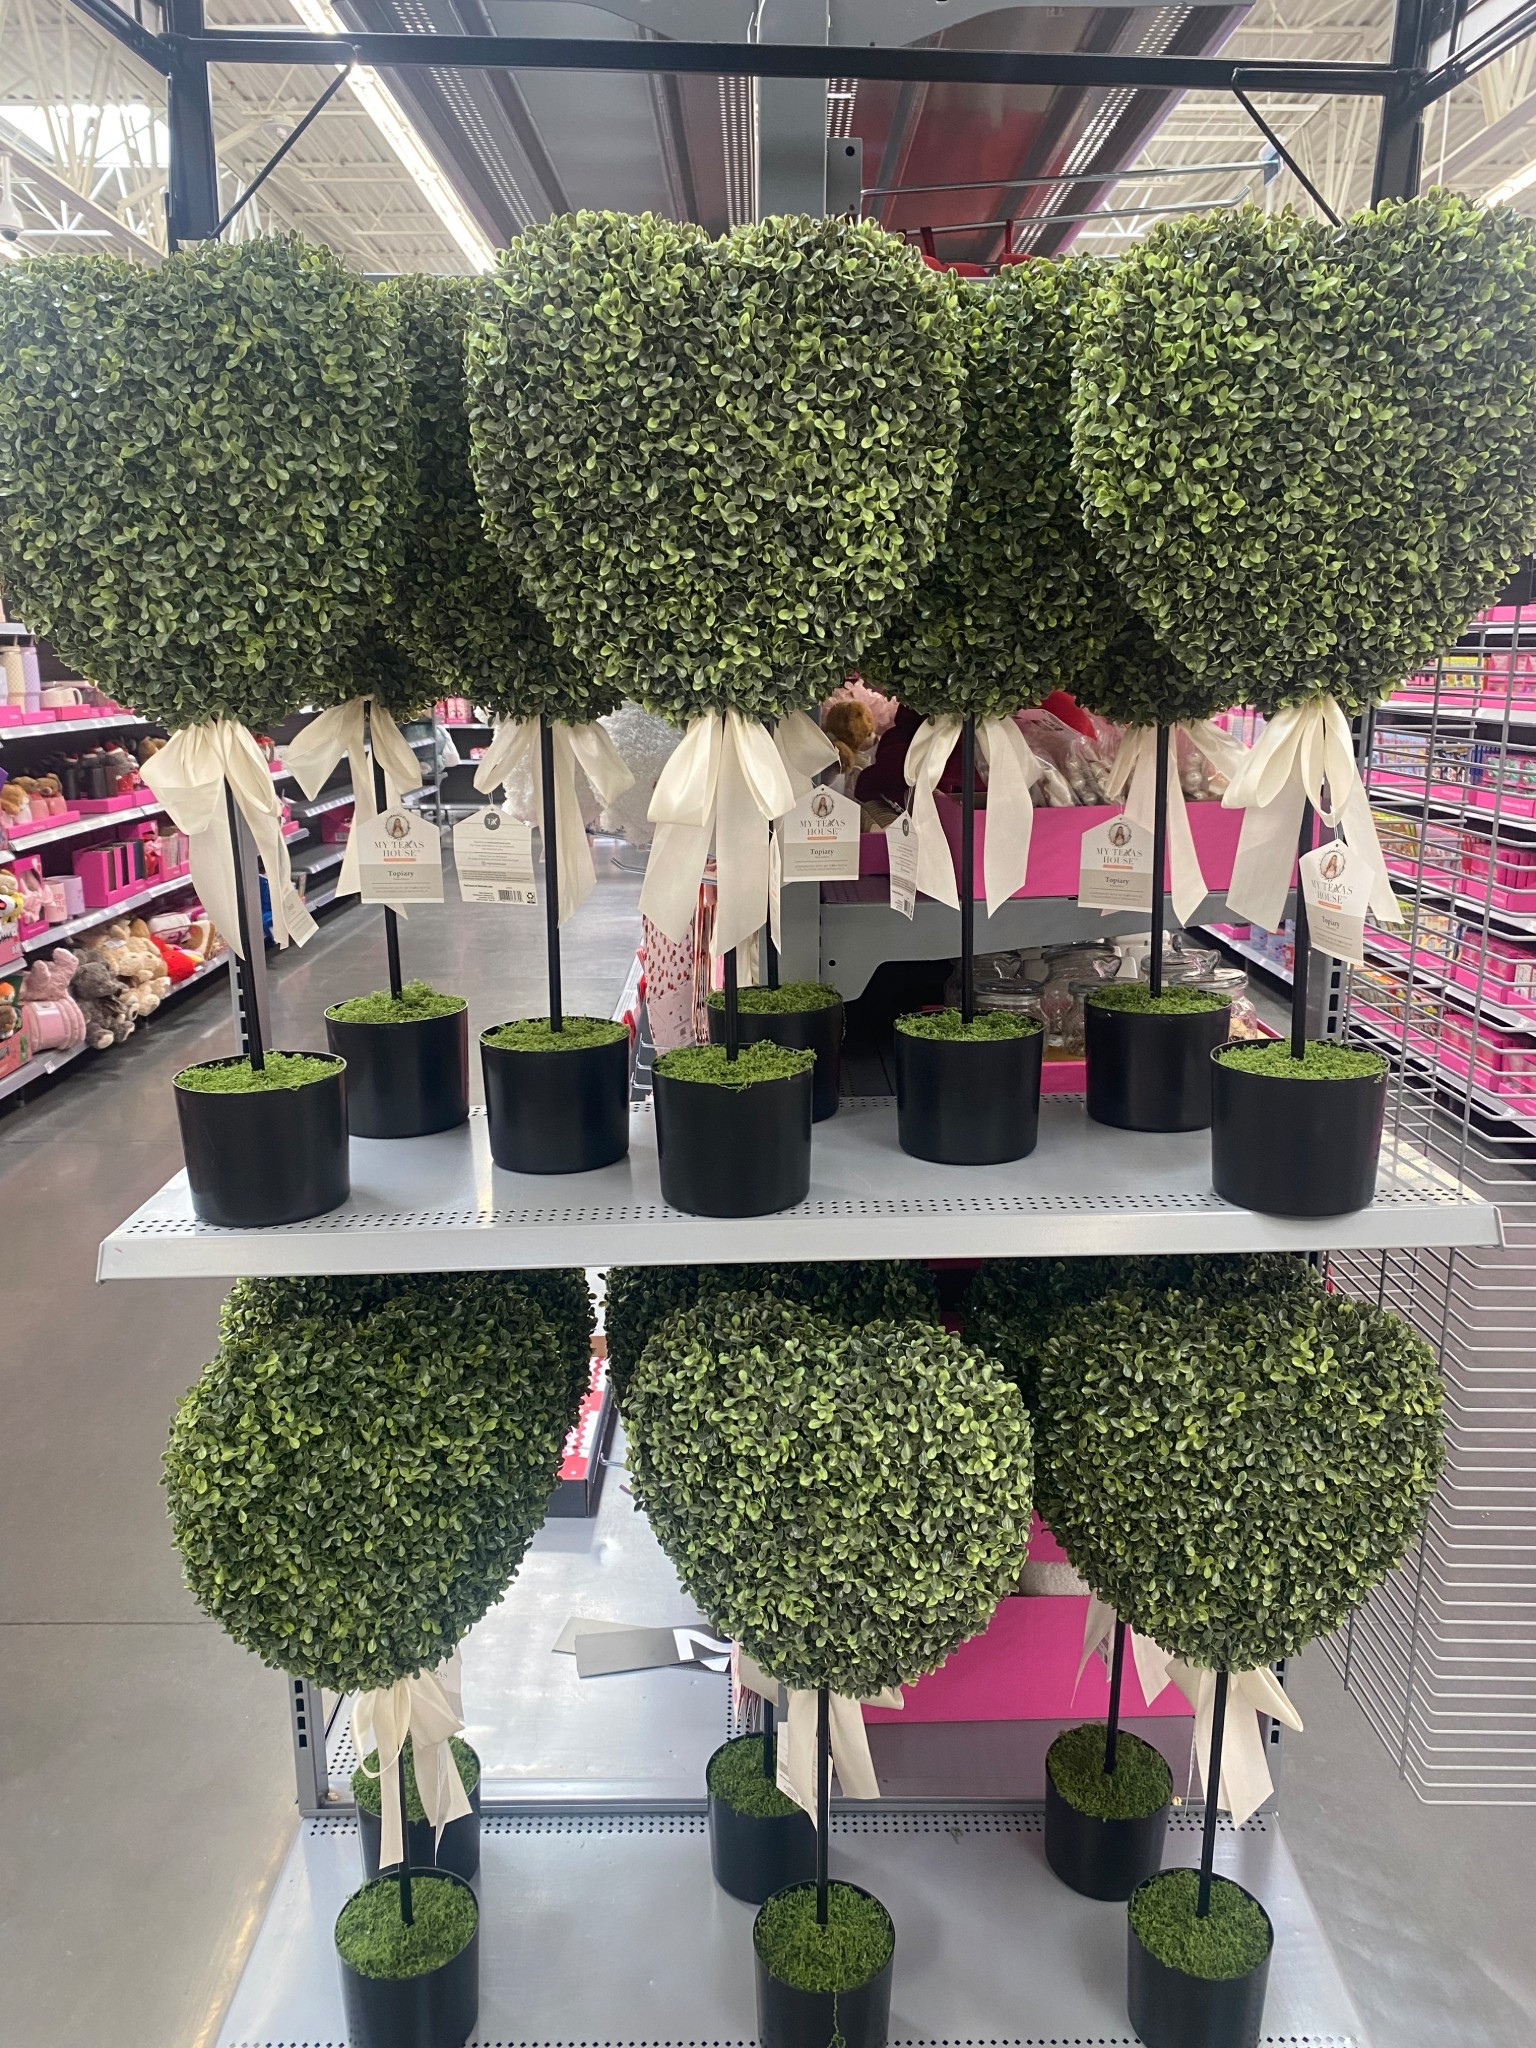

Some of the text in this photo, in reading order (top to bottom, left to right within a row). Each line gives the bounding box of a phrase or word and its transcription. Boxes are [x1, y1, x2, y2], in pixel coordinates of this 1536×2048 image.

[799, 818, 846, 828] MY TEXAS
[374, 840, 425, 849] MY TEXAS
[810, 849, 834, 857] Topiary
[1096, 847, 1143, 858] MY TEXAS
[1105, 877, 1130, 885] Topiary
[1311, 879, 1353, 895] MY TEXAS
[1321, 916, 1340, 927] Topiary
